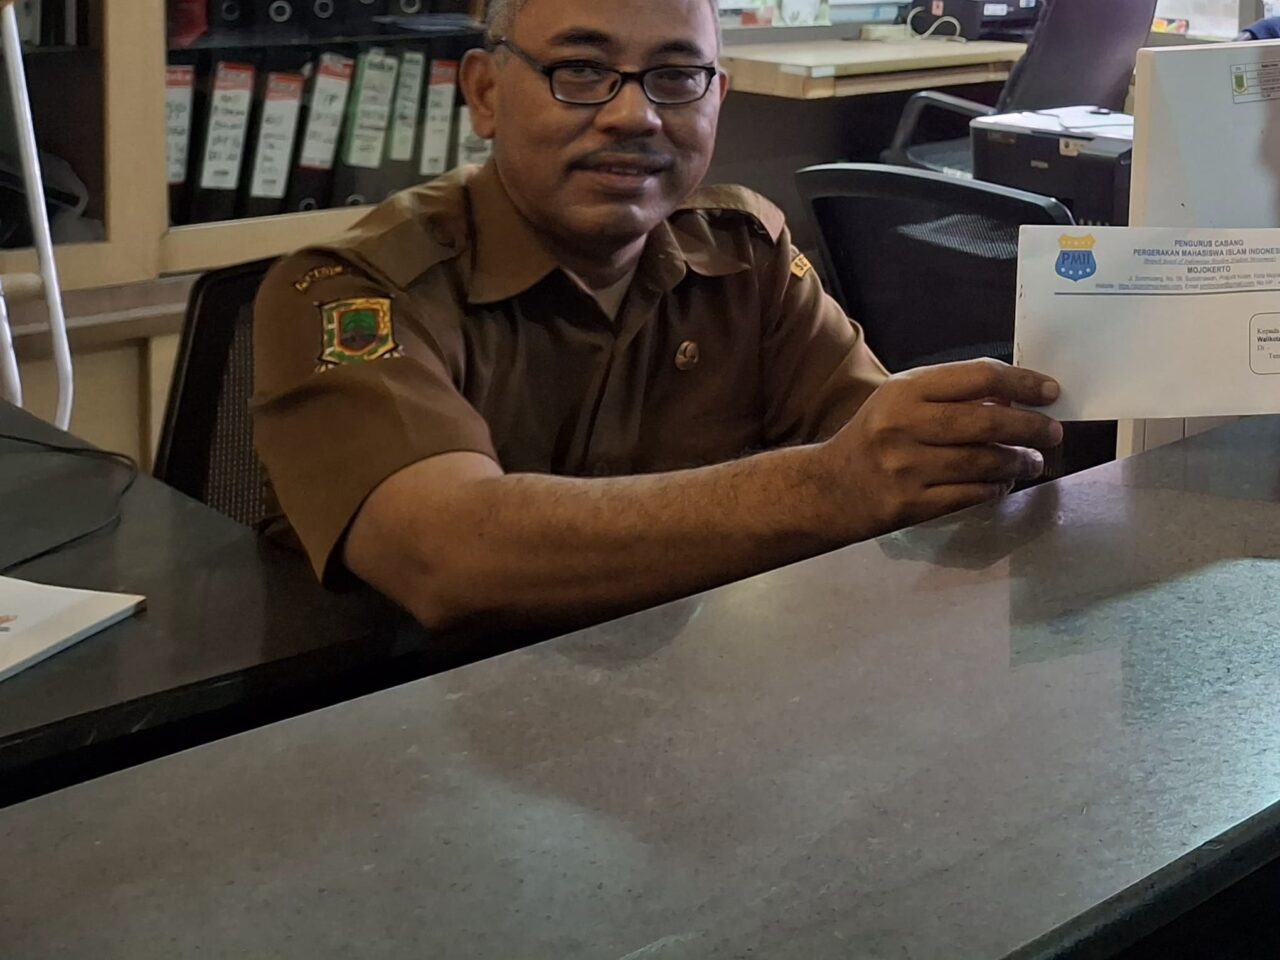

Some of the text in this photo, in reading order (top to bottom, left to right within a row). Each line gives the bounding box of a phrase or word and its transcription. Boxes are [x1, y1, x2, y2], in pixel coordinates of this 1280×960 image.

[1174, 239, 1244, 247] PENGURUS CABANG
[1133, 248, 1180, 257] PERGERAKAN
[1181, 248, 1225, 256] MAHASISWA
[1225, 248, 1247, 256] ISLAM
[1062, 252, 1090, 265] PMII
[1187, 265, 1231, 273] MOJOKERTO
